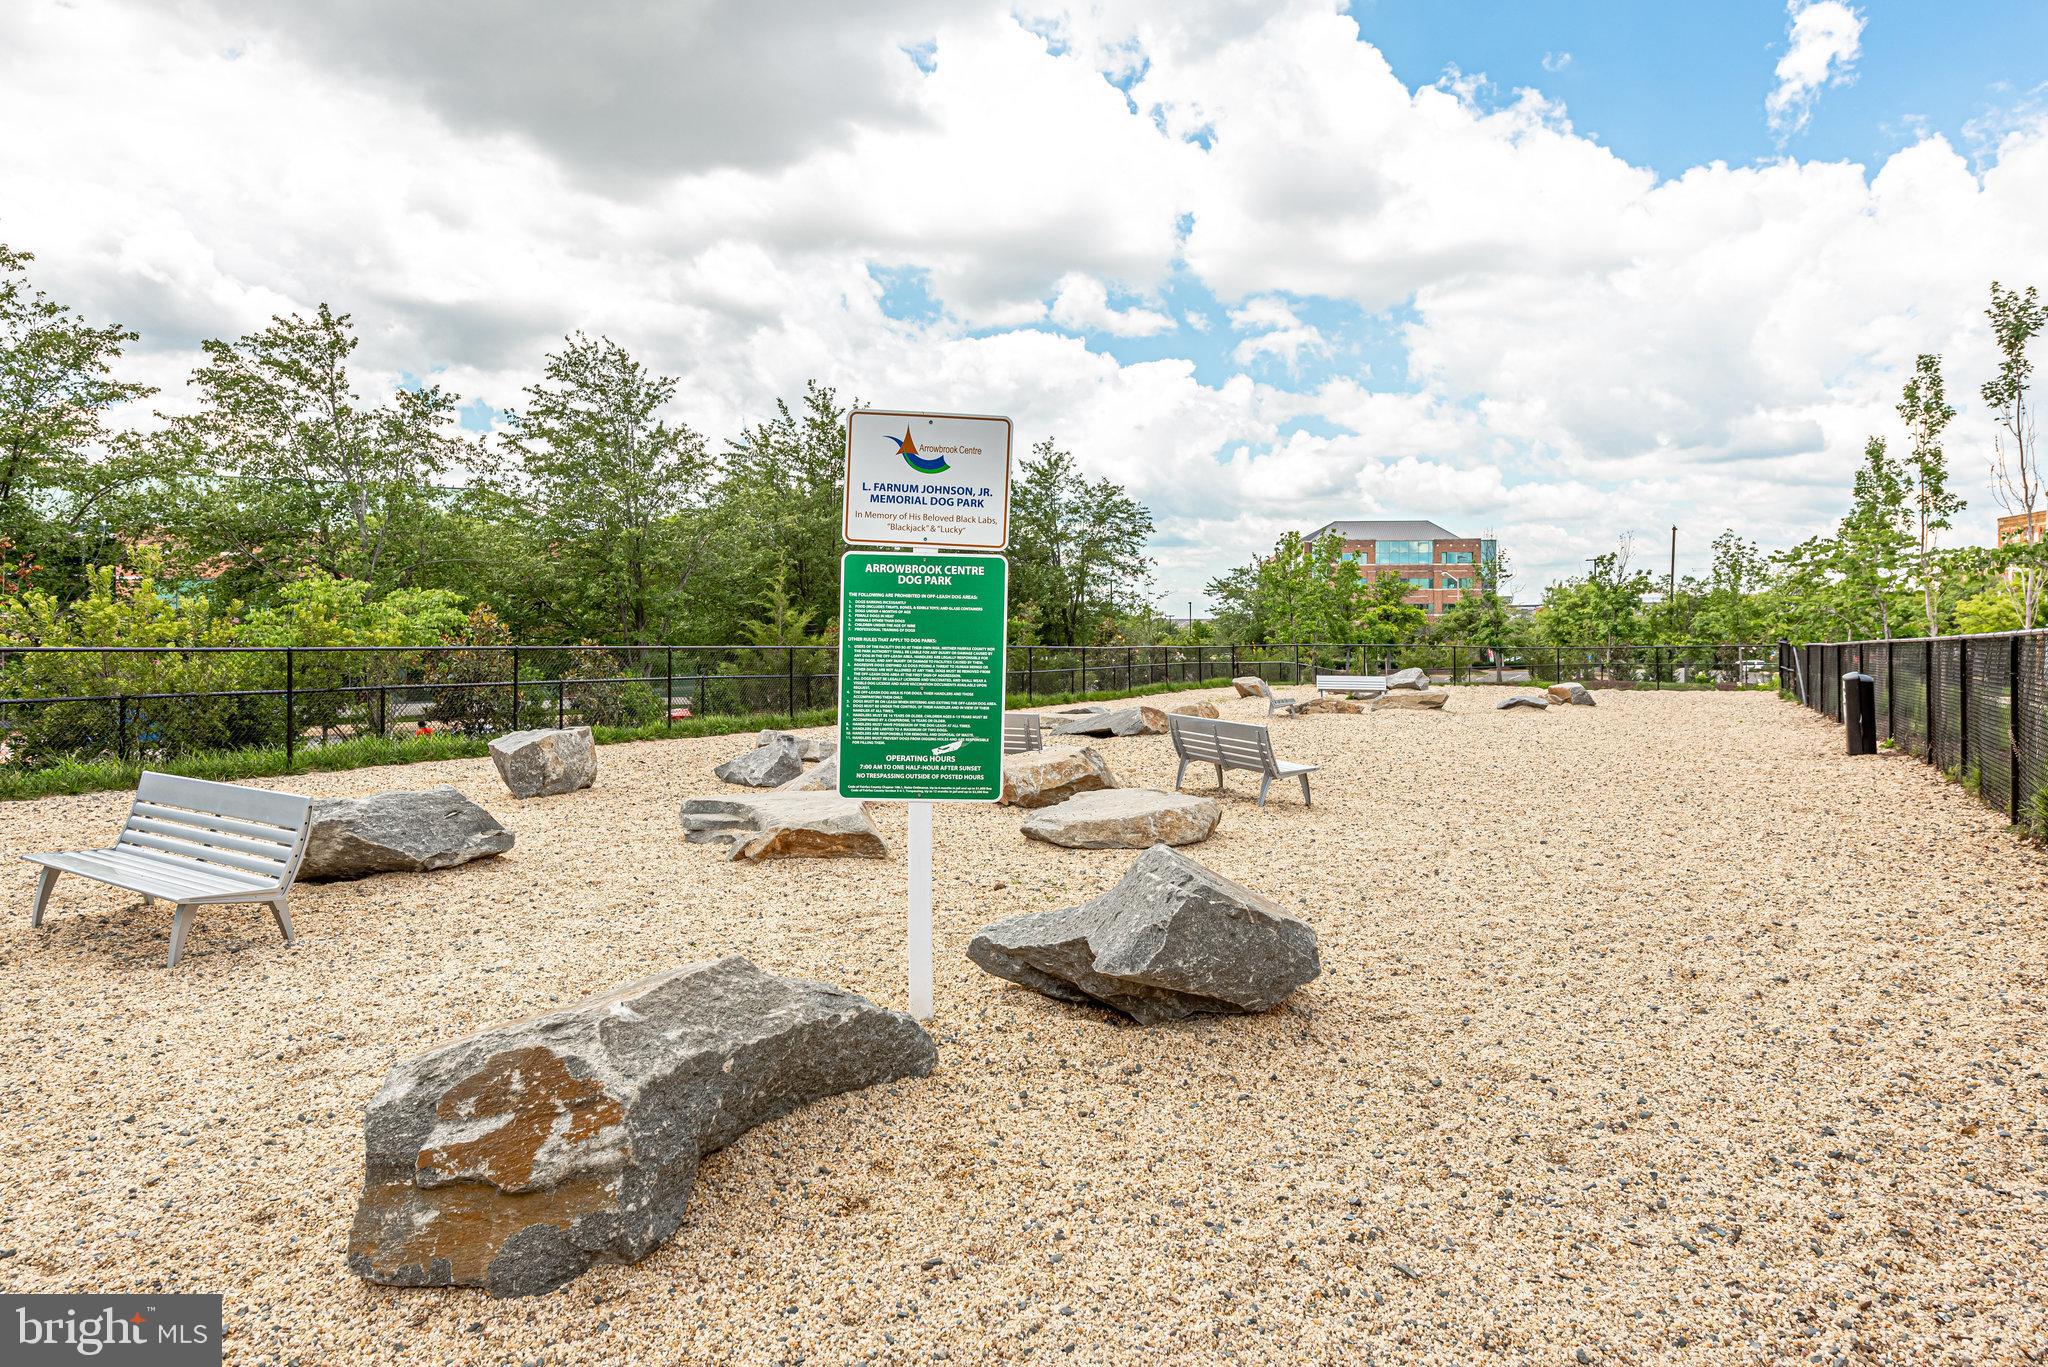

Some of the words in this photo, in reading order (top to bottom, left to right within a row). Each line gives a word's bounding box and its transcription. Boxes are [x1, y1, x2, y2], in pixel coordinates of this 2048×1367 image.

[920, 444, 958, 454] Arrowbrook
[960, 446, 982, 455] Centre
[863, 482, 871, 491] L.
[874, 483, 919, 493] FARNUM
[921, 485, 975, 497] JOHNSON,
[978, 488, 993, 497] JR.
[870, 495, 927, 505] MEMORIAL
[931, 497, 954, 506] DOG
[957, 498, 984, 507] PARK
[865, 512, 897, 521] Memory
[923, 514, 954, 522] Beloved
[956, 515, 976, 523] Black
[978, 516, 998, 525] Labs,
[866, 564, 942, 574] ARROWBROOK
[944, 566, 984, 575] CENTRE
[898, 575, 922, 584] DOG
[924, 576, 952, 585] PARK
